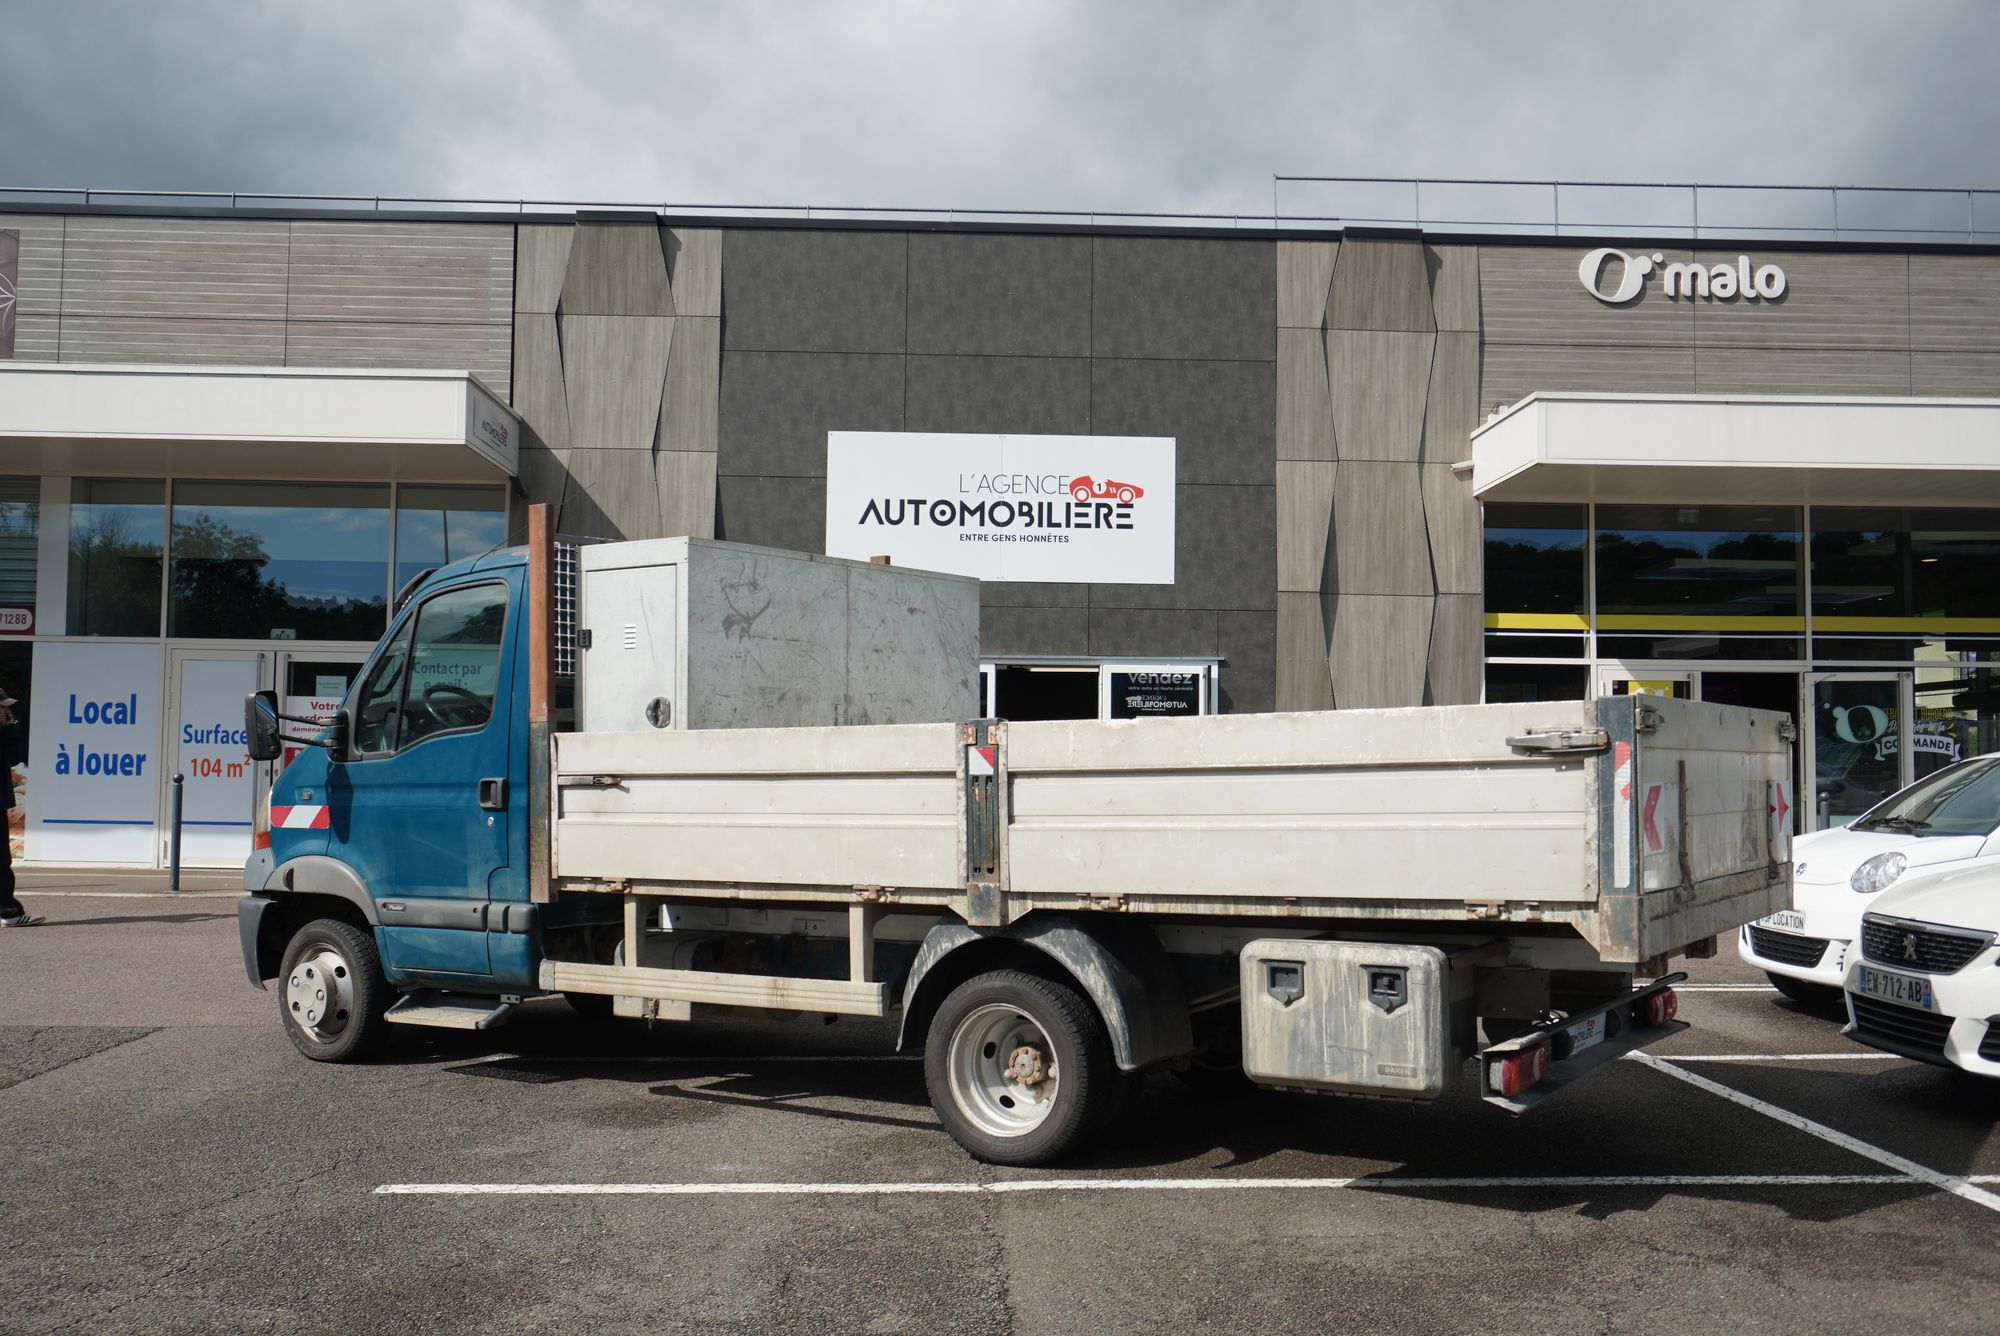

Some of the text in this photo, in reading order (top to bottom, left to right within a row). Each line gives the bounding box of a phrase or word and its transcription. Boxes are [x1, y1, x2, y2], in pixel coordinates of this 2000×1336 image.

[959, 473, 1070, 495] L'AGENCE
[1096, 483, 1102, 492] 1
[959, 532, 1070, 544] ENTRE GENS HONNÊTES
[414, 662, 482, 677] Contact par
[69, 694, 137, 725] Local
[183, 723, 248, 745] Surface
[1884, 738, 1952, 752] COMANDE
[55, 743, 147, 776] à louer
[191, 757, 222, 778] 104
[1773, 912, 1804, 931] LOCATION
